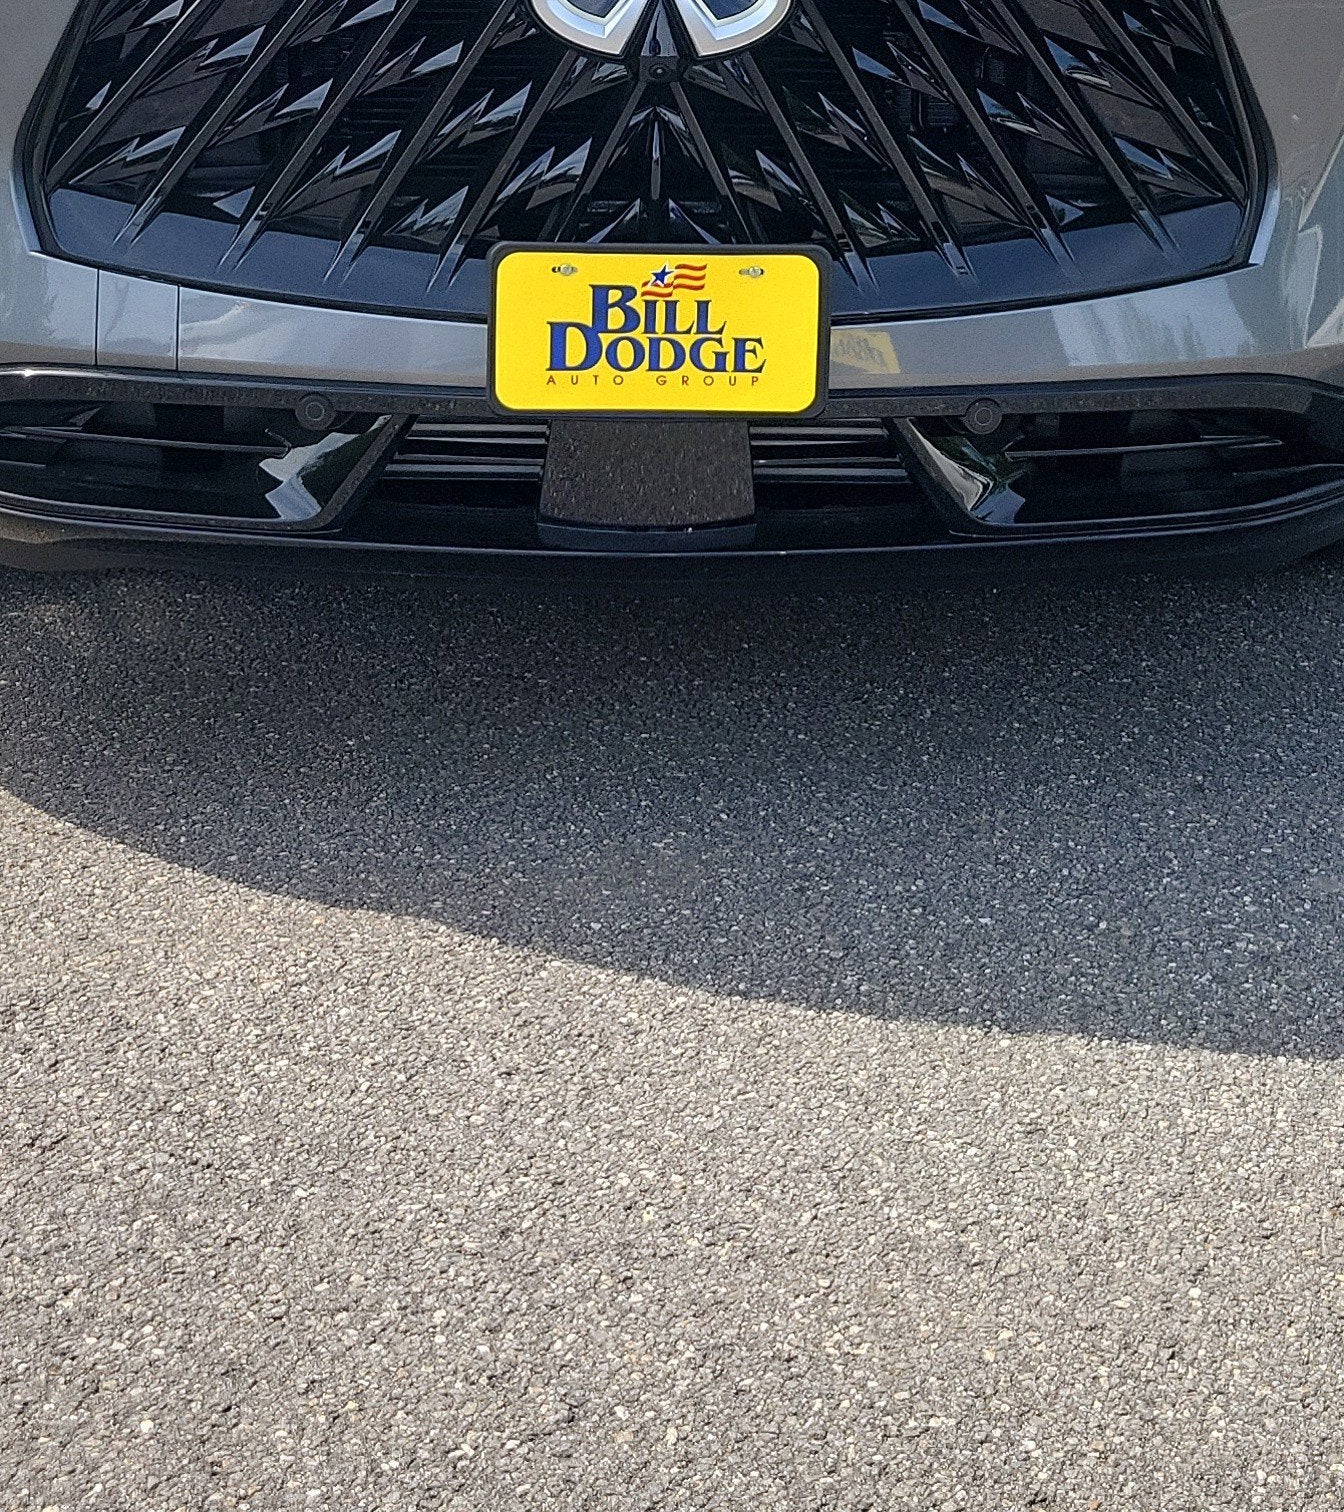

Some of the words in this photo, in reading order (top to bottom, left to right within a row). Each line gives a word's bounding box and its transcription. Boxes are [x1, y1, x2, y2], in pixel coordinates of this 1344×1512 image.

[588, 284, 727, 335] BILL
[545, 320, 767, 374] DODGE
[546, 375, 625, 387] AUTO
[655, 375, 759, 387] GROUP
